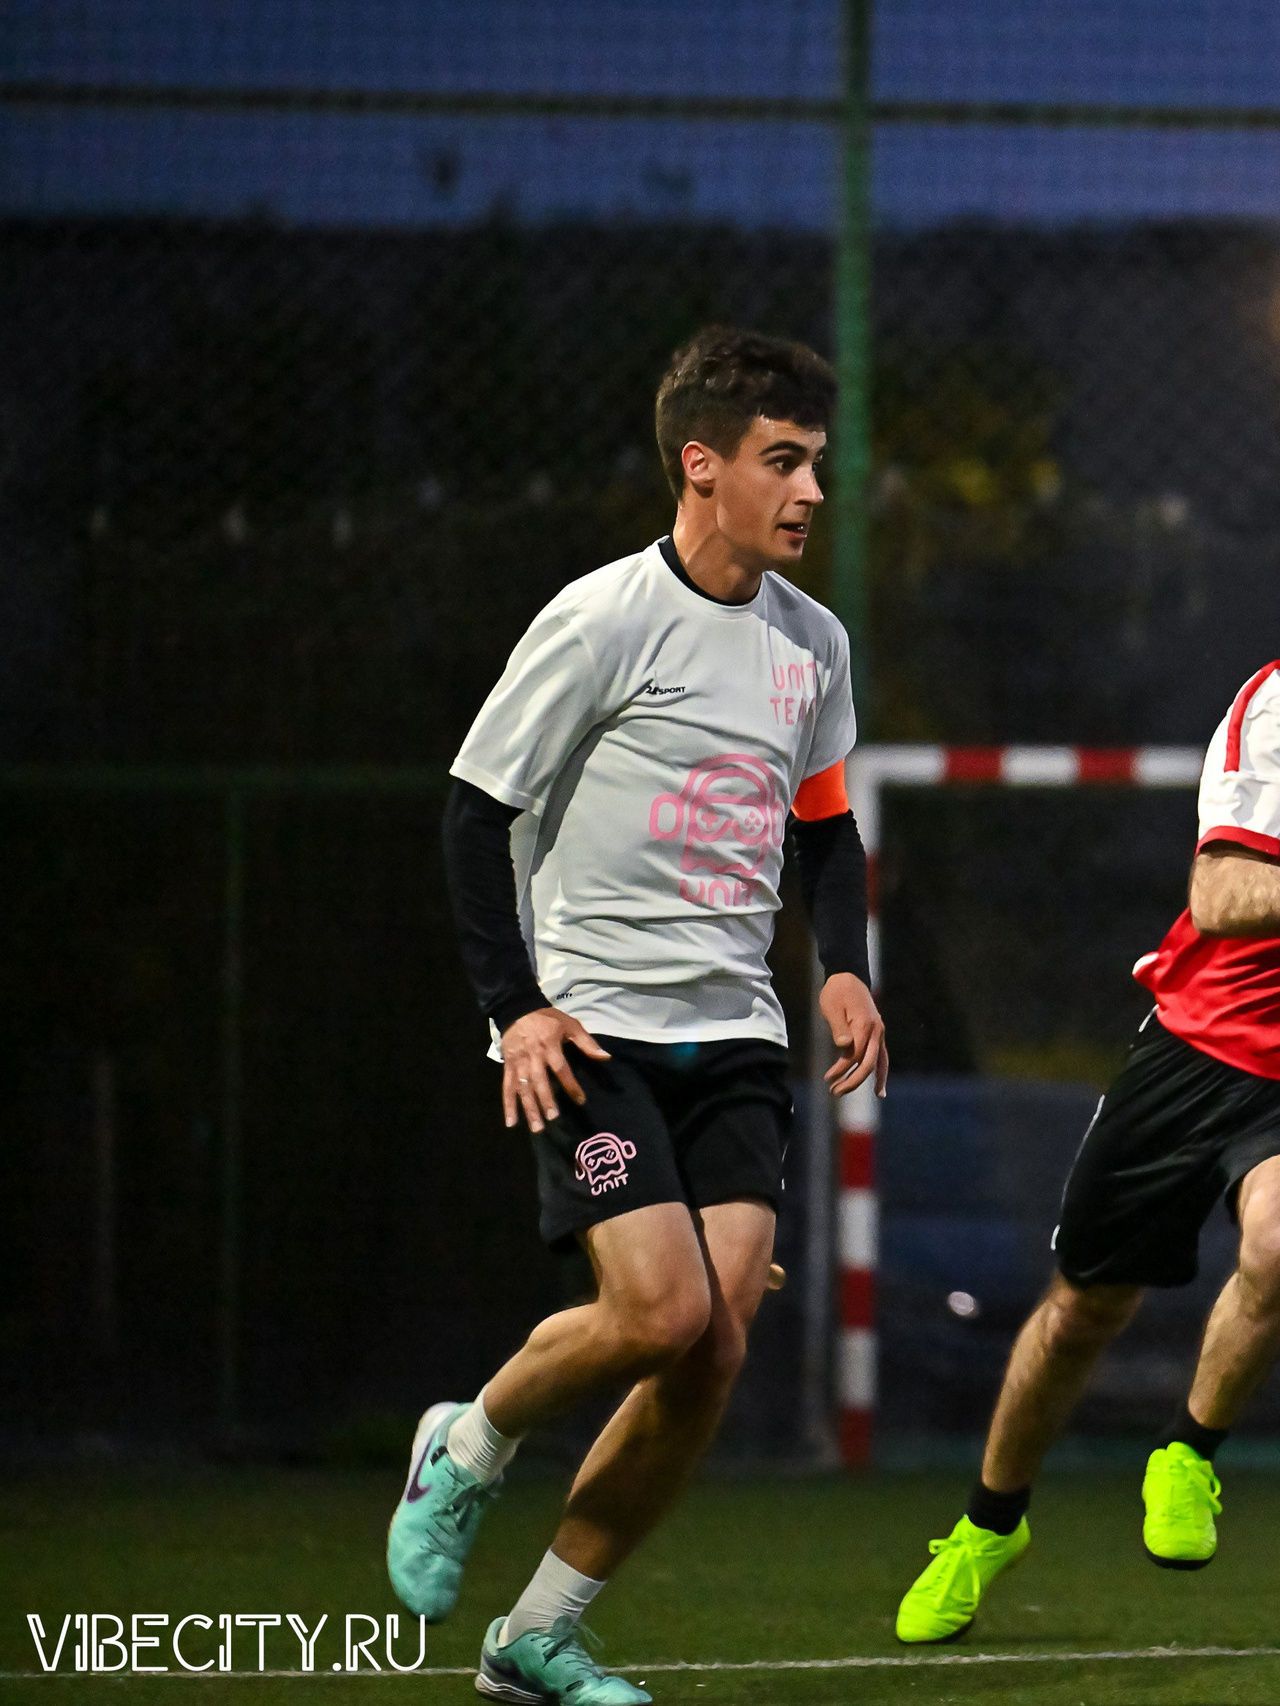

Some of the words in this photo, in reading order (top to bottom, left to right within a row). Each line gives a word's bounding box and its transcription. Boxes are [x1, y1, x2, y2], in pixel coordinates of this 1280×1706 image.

[771, 662, 817, 691] UNIT
[679, 878, 762, 907] UNIT
[591, 1173, 629, 1196] UNIT
